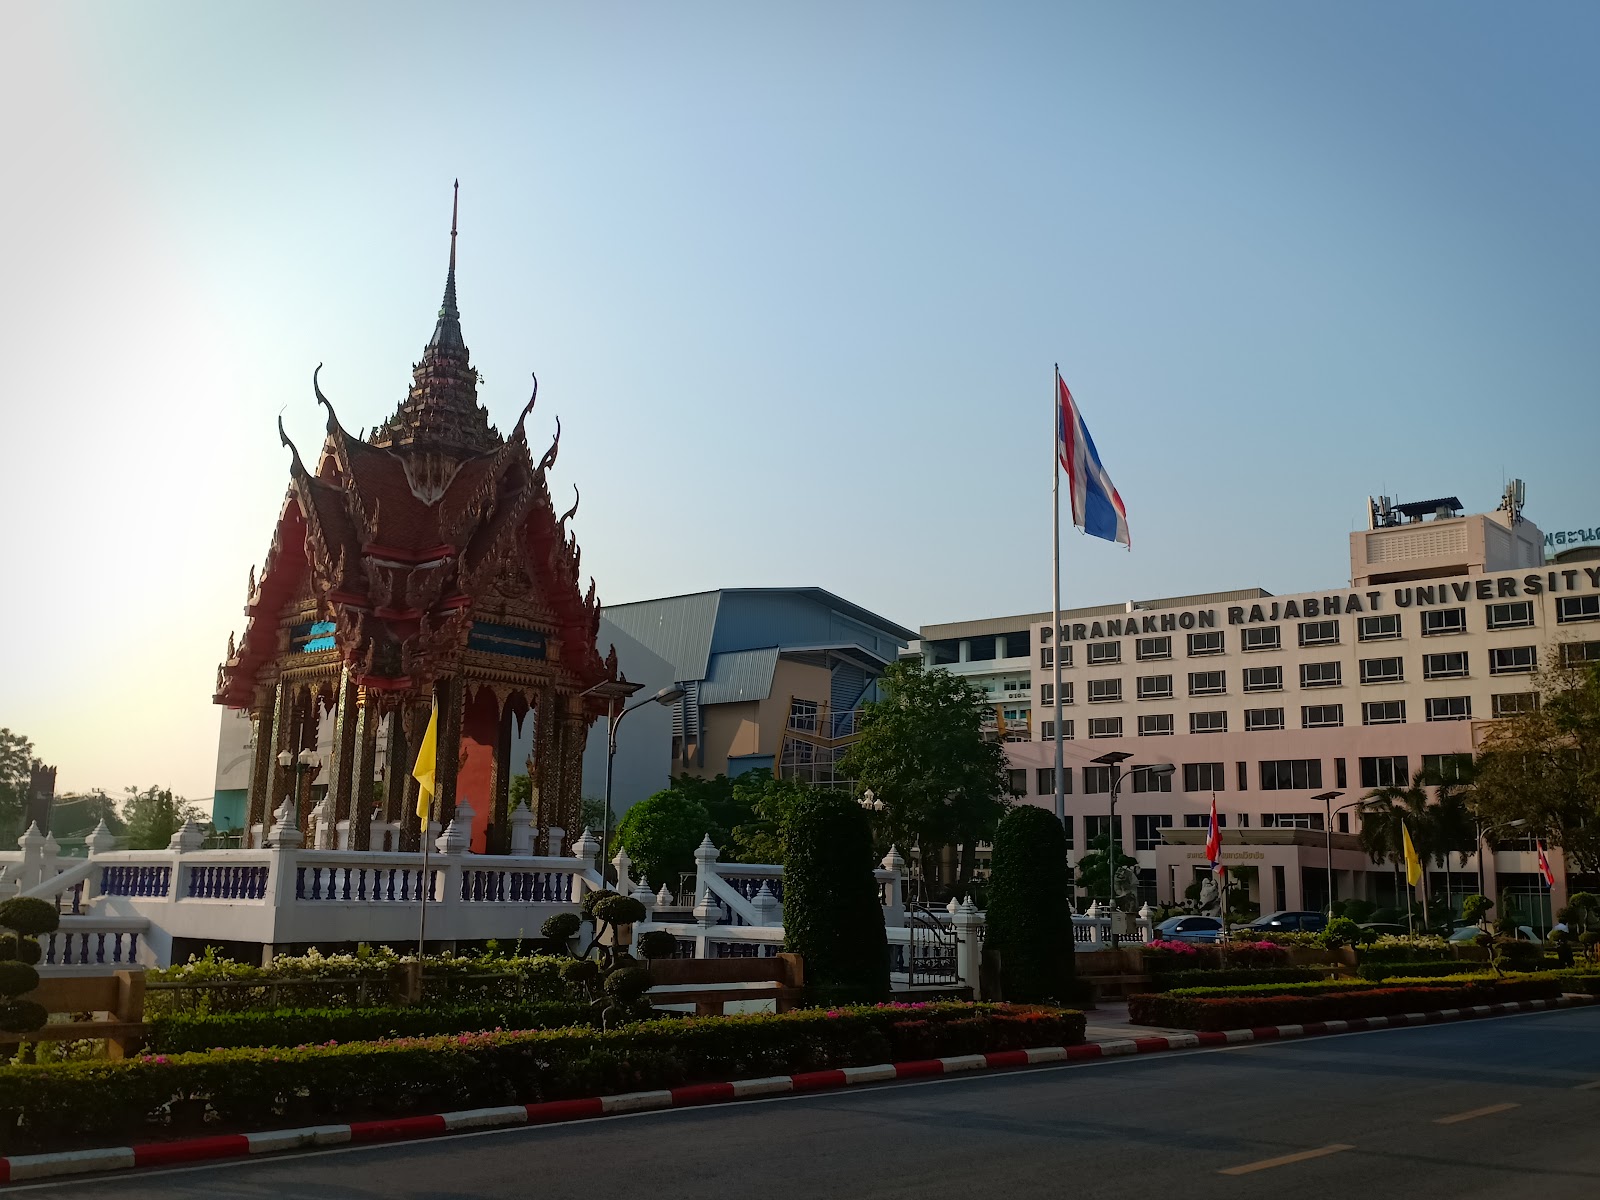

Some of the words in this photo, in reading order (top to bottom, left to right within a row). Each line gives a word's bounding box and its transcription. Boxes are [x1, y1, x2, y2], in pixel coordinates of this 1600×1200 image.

[1040, 609, 1214, 644] PHRANAKHON
[1228, 591, 1381, 625] RAJABHAT
[1394, 567, 1600, 608] UNIVERSITY
